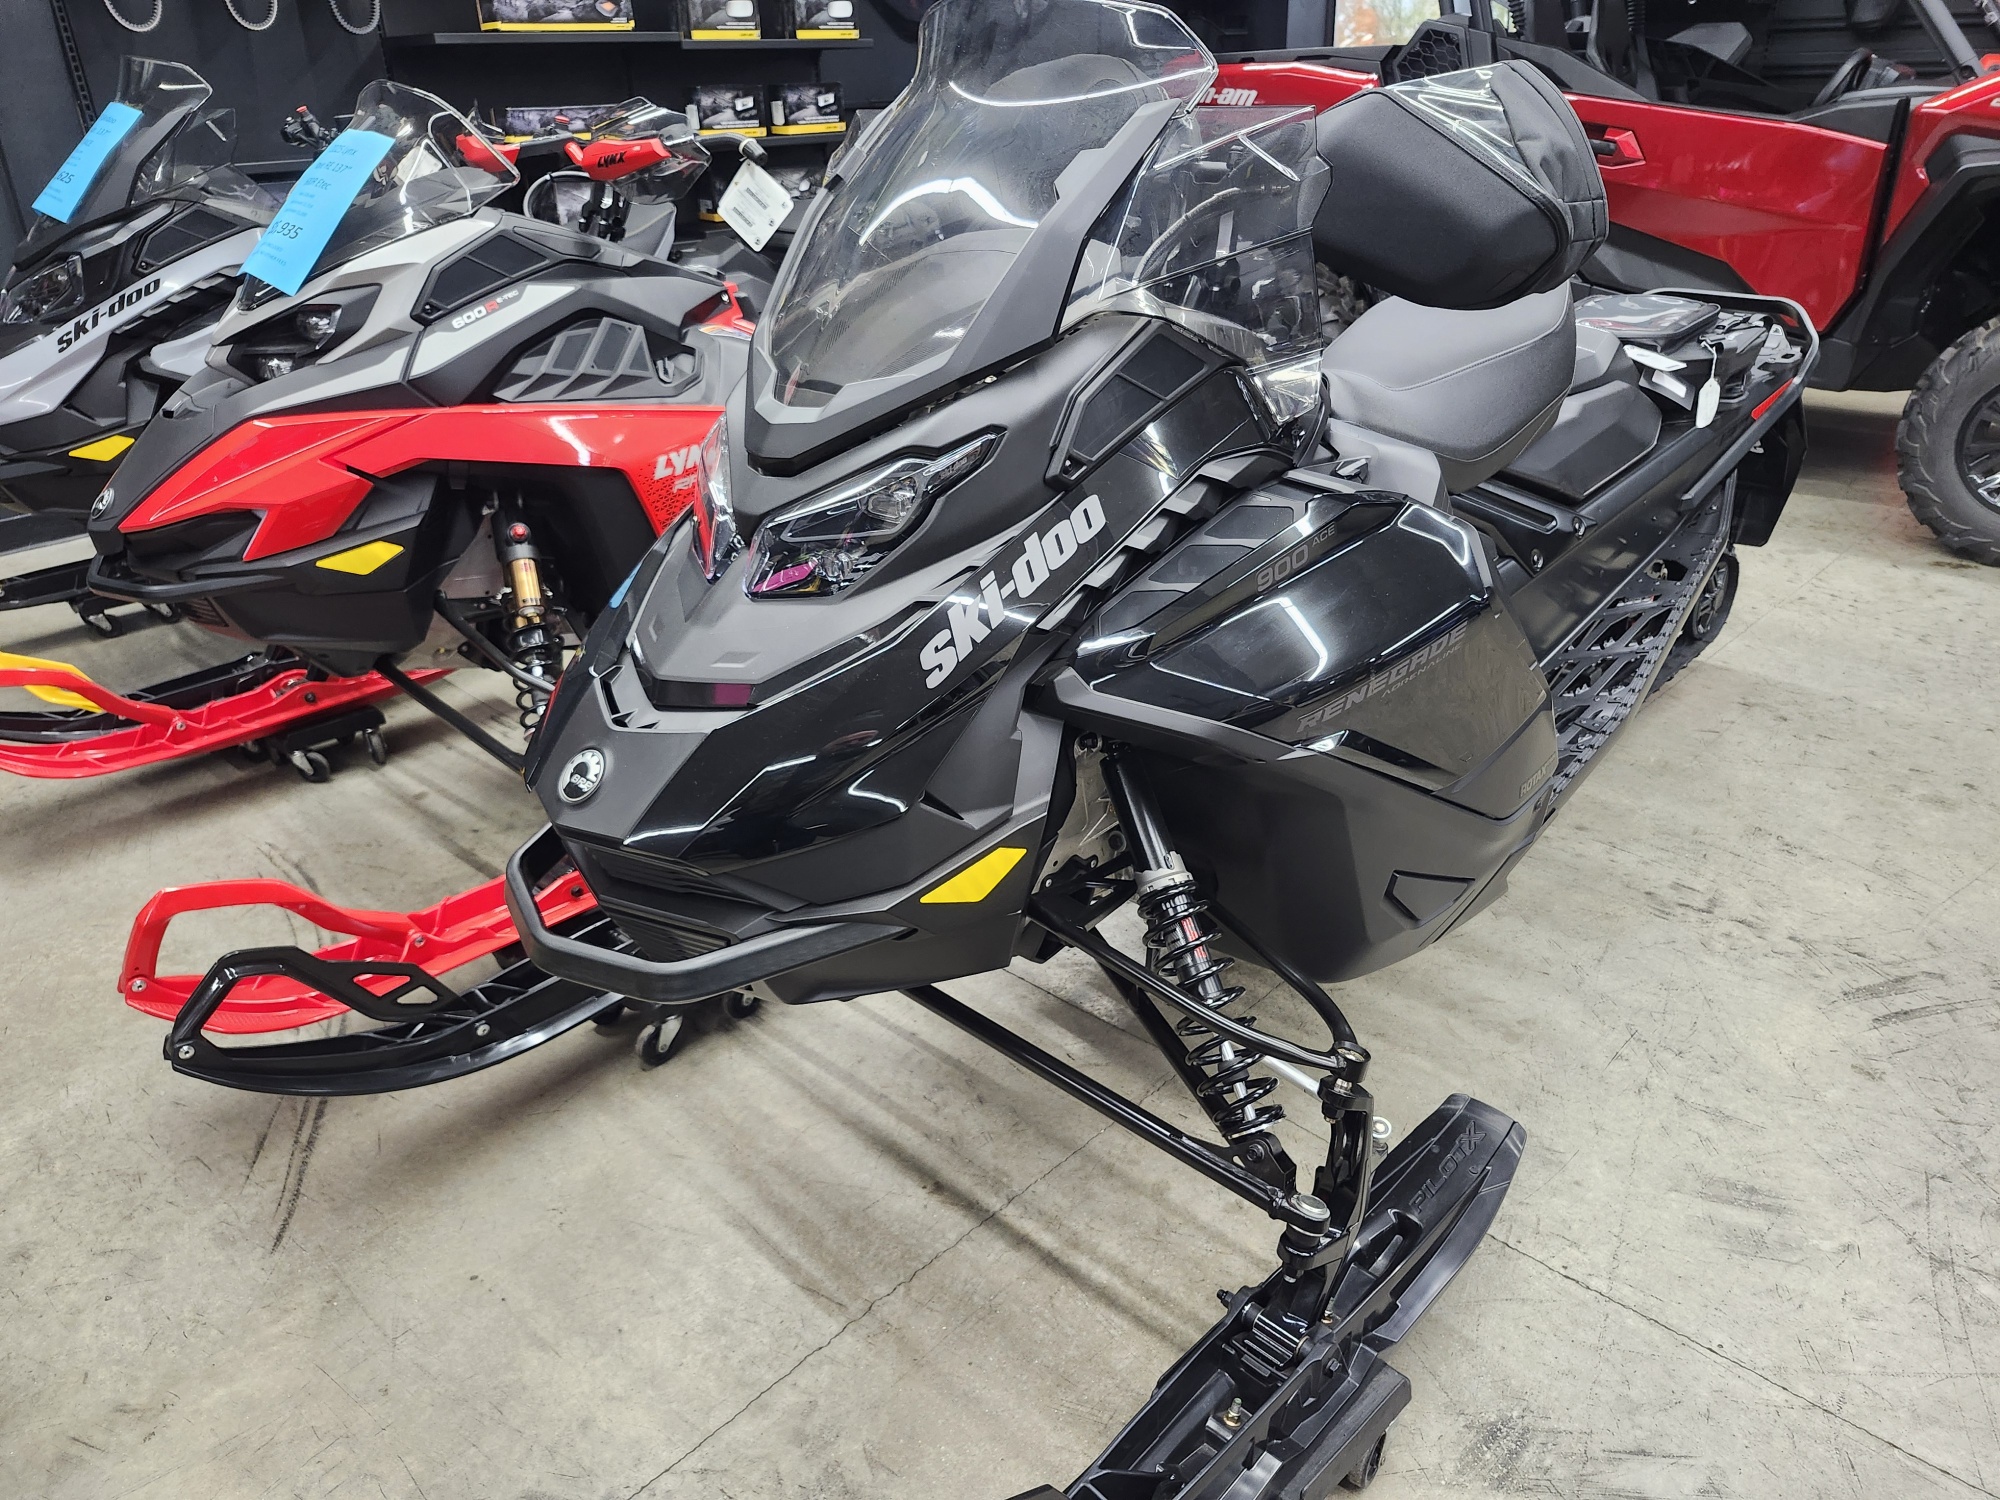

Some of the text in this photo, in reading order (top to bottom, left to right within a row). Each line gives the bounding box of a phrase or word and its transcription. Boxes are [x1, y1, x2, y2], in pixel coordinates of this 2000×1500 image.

[1199, 87, 1258, 106] n-am
[597, 151, 627, 168] LYNX
[57, 278, 161, 354] ski-doo
[653, 444, 701, 481] LYN
[1257, 524, 1336, 592] 900 ACE
[919, 494, 1106, 690] ski-doo
[1297, 620, 1468, 733] RENEGADE
[1381, 643, 1466, 698] ADRENALINE
[570, 773, 594, 792] BRP
